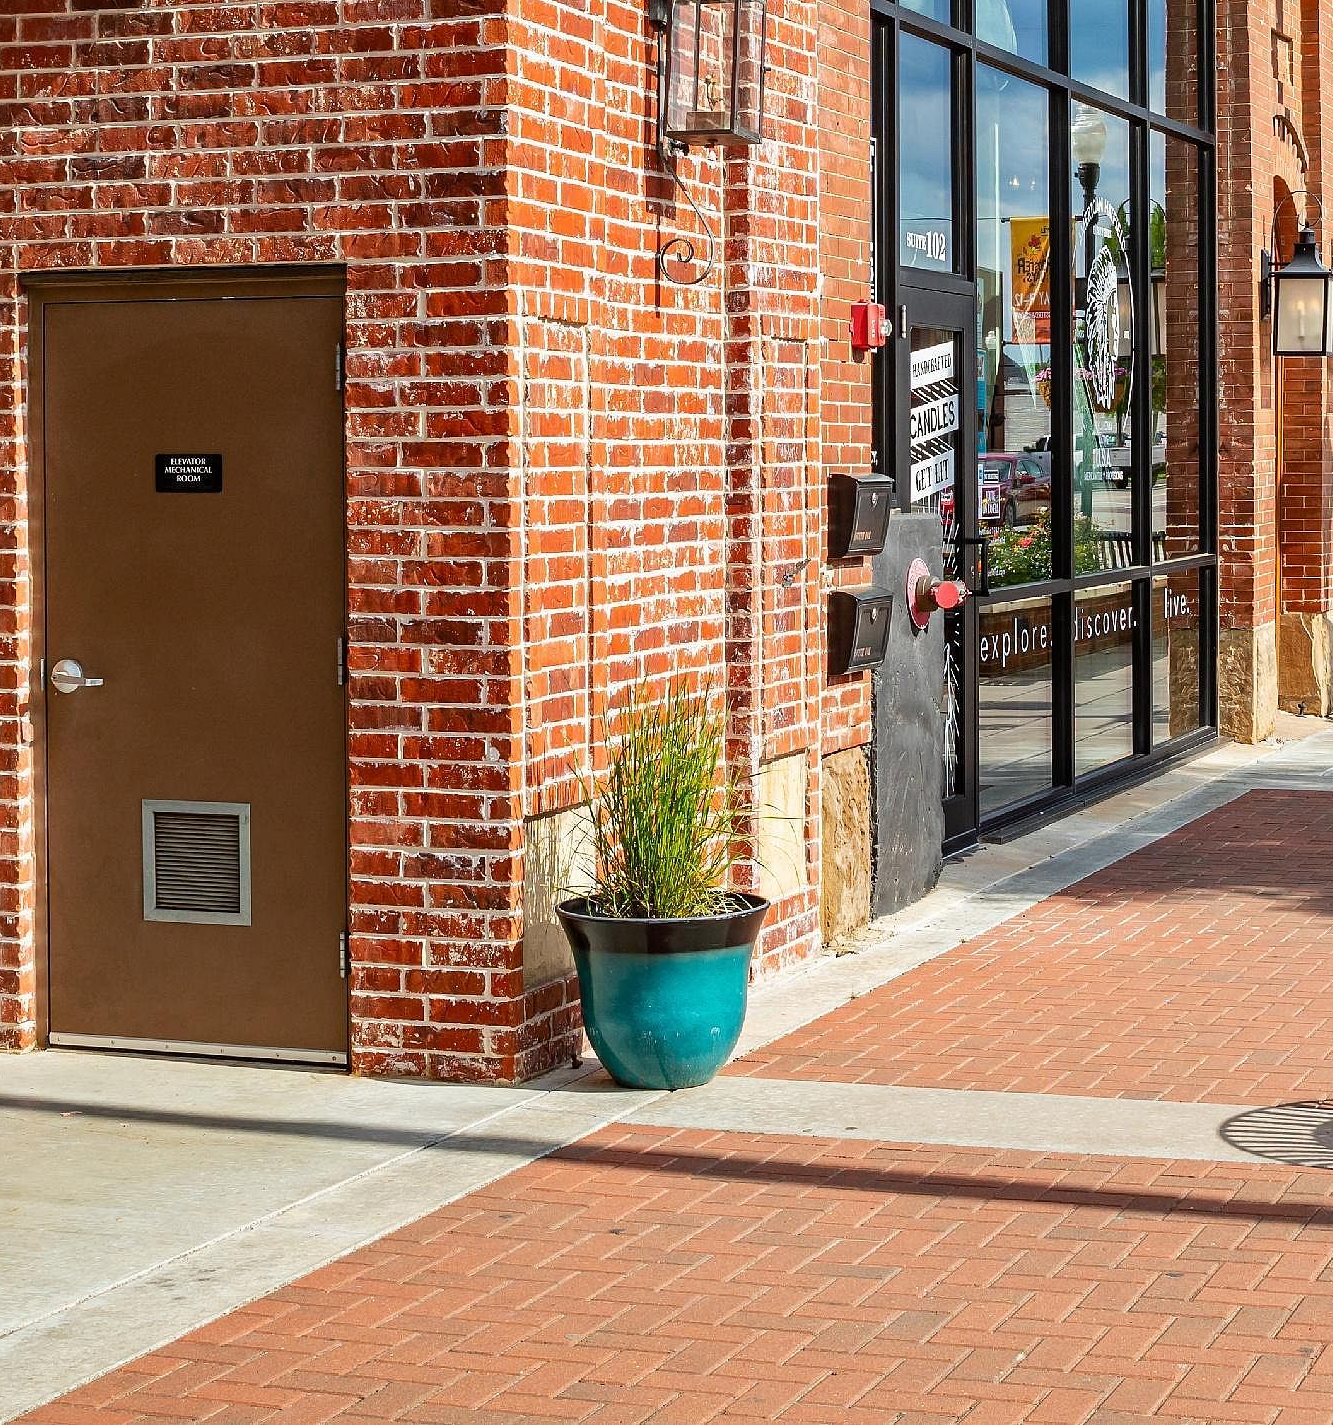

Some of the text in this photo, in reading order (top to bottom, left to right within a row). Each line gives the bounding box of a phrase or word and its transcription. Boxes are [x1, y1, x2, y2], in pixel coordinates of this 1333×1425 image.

[906, 230, 946, 262] SUITE 102
[910, 400, 956, 440] CANDLES
[164, 466, 213, 474] MECHANICAL
[170, 457, 206, 466] ELEVATOR
[915, 458, 949, 492] GET LIT
[176, 474, 201, 482] ROOM
[1164, 587, 1190, 619] live.
